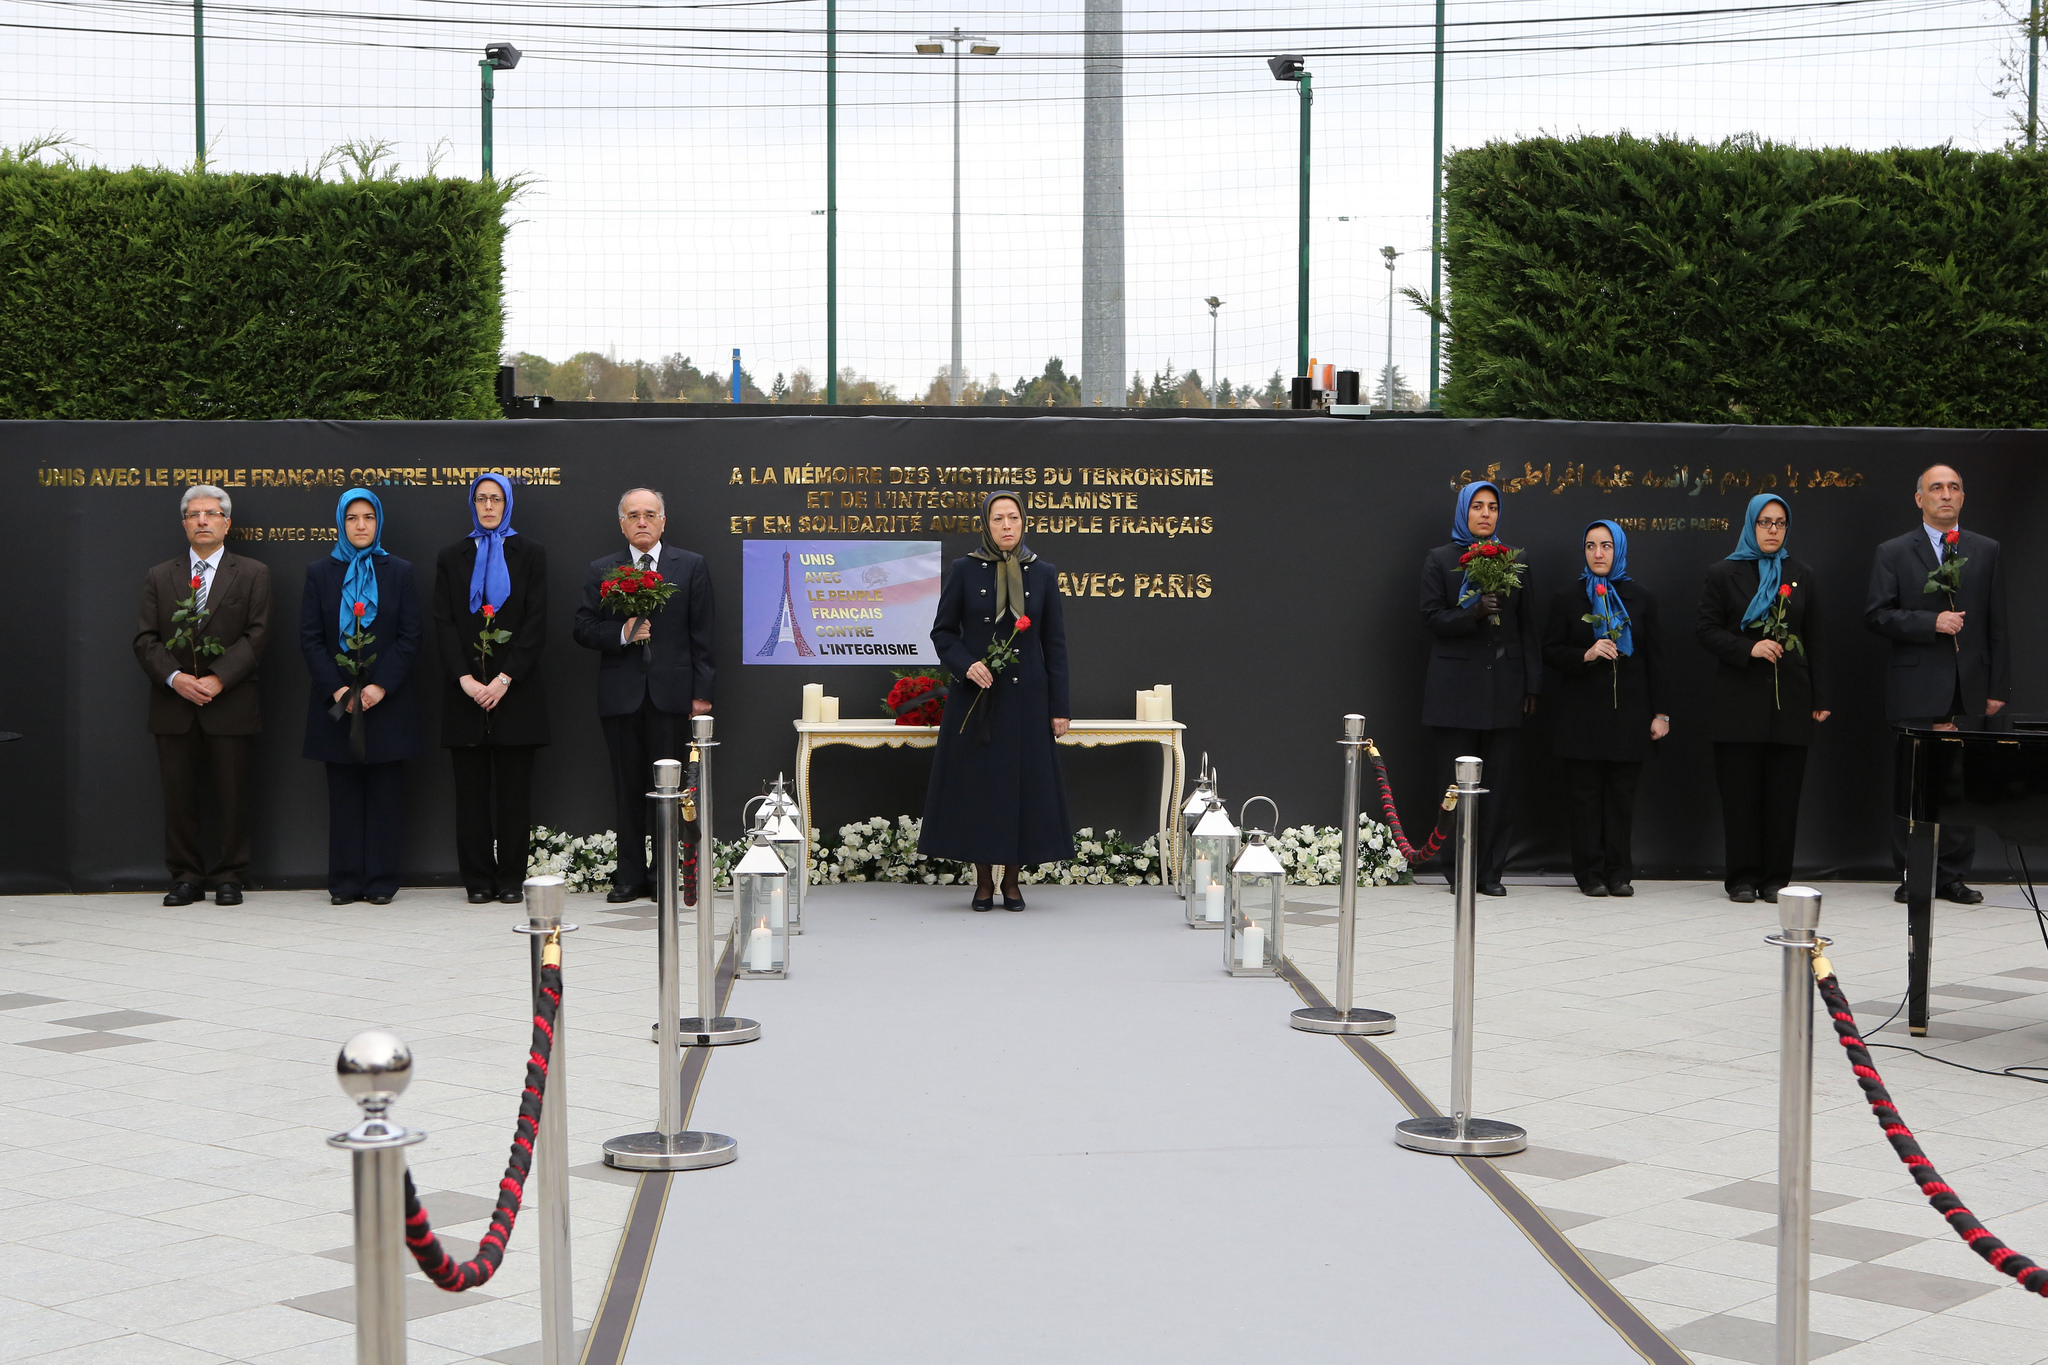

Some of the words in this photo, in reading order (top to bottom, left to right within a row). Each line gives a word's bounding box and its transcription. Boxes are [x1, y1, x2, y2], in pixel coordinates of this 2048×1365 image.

[38, 468, 85, 487] UNIS
[90, 468, 141, 487] AVEC
[145, 468, 169, 487] LE
[173, 468, 247, 487] PEUPLE
[251, 468, 346, 492] FRANÇAIS
[350, 467, 427, 487] CONTRE
[728, 466, 744, 485] A
[750, 467, 777, 485] LA
[783, 462, 883, 485] MÉMOIRE
[889, 467, 930, 485] DES
[936, 467, 1037, 485] VICTIMES
[1043, 467, 1073, 485] DU
[1079, 467, 1214, 486] TERRORISME
[807, 491, 833, 509] ET
[840, 491, 867, 509] DE
[874, 487, 1020, 509] L'INTÉGRIS
[1027, 491, 1138, 510] ISLAMISTE
[730, 515, 757, 534] ET
[763, 516, 791, 534] EN
[798, 512, 923, 534] SOLIDARITÉ
[929, 515, 982, 534] AVEC
[1025, 516, 1102, 534] PEUPLE
[1109, 516, 1214, 538] FRANÇAIS
[1651, 517, 1686, 531] AVEC
[1690, 517, 1730, 531] PARIS
[230, 527, 264, 542] UNIS
[268, 527, 306, 541] AVEC
[310, 527, 338, 541] PAR
[799, 553, 835, 566] UNIS
[804, 571, 842, 584] AVEC
[1057, 572, 1125, 598] AVEC
[1134, 572, 1213, 598] PARIS
[807, 590, 824, 602] LE
[828, 590, 884, 602] PEUPLE
[811, 607, 884, 622] FRANÇAIS
[815, 625, 874, 638] CONTRE
[819, 643, 918, 656] L'INTEGRISME
